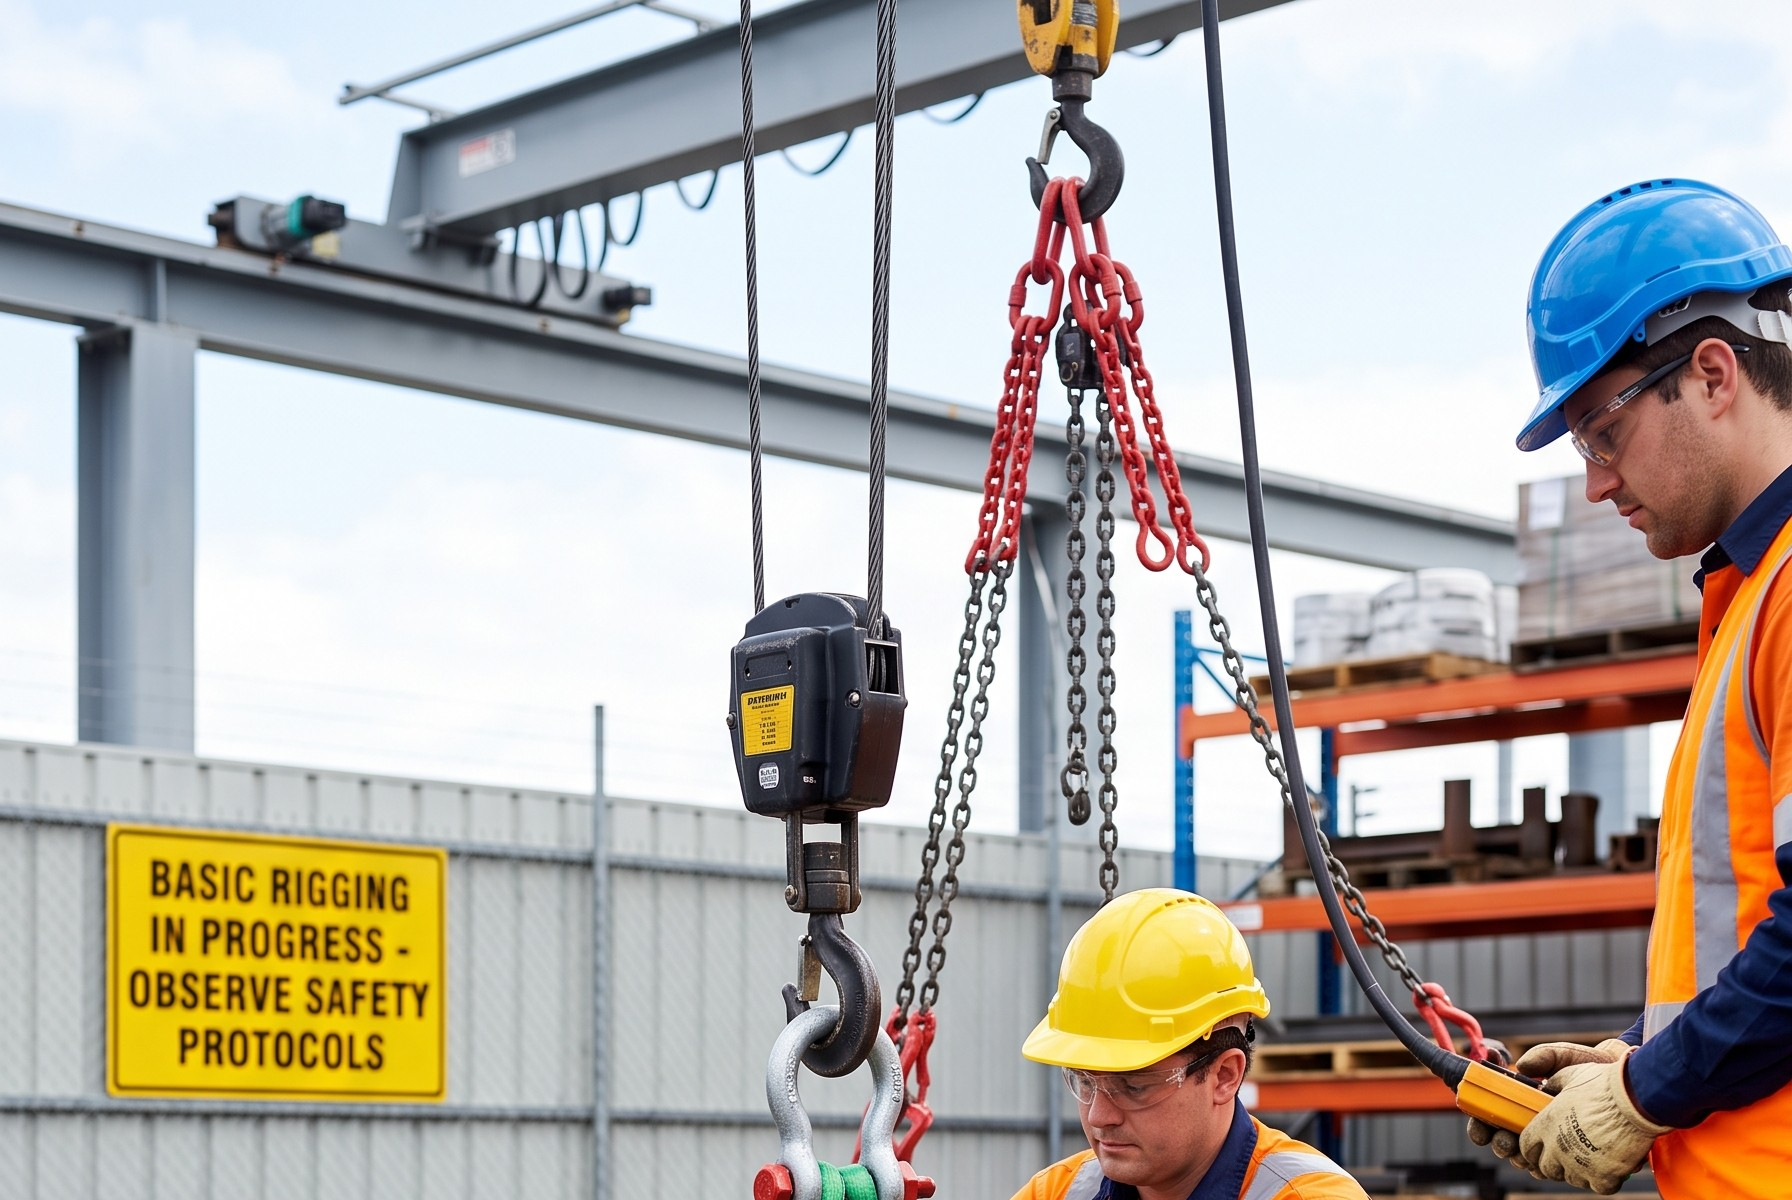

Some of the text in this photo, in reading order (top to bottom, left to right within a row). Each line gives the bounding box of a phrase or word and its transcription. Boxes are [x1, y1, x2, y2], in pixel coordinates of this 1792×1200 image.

[150, 859, 410, 912] BASIC RIGGING
[152, 915, 185, 954] IN
[202, 918, 383, 963] PROGRESS
[129, 969, 429, 1018] OBSERVE SAFETY
[179, 1027, 384, 1071] PROTOCOLS
